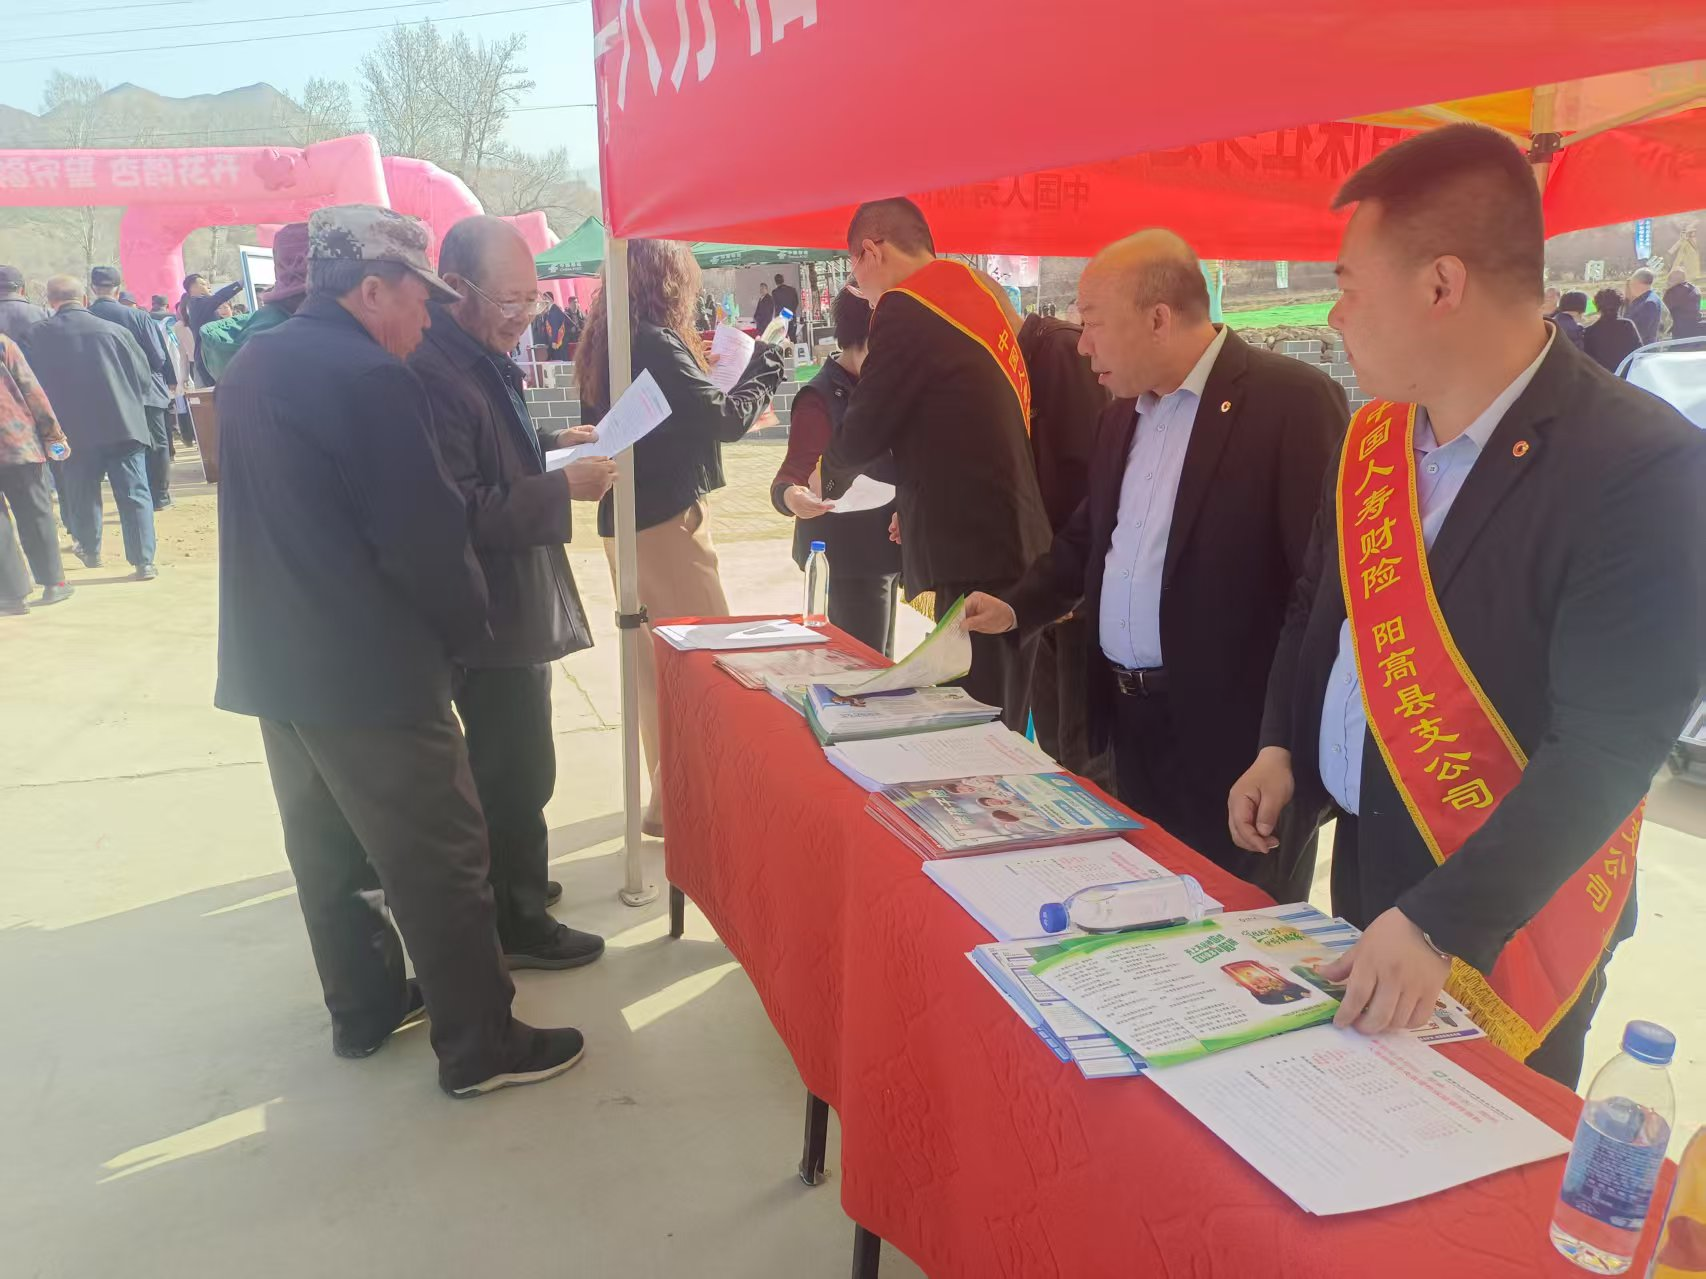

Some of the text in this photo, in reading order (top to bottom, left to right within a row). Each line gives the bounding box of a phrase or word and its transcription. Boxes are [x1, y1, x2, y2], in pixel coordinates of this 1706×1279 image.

[1354, 401, 1494, 810] 中国人寿财险 阳高县支公司
